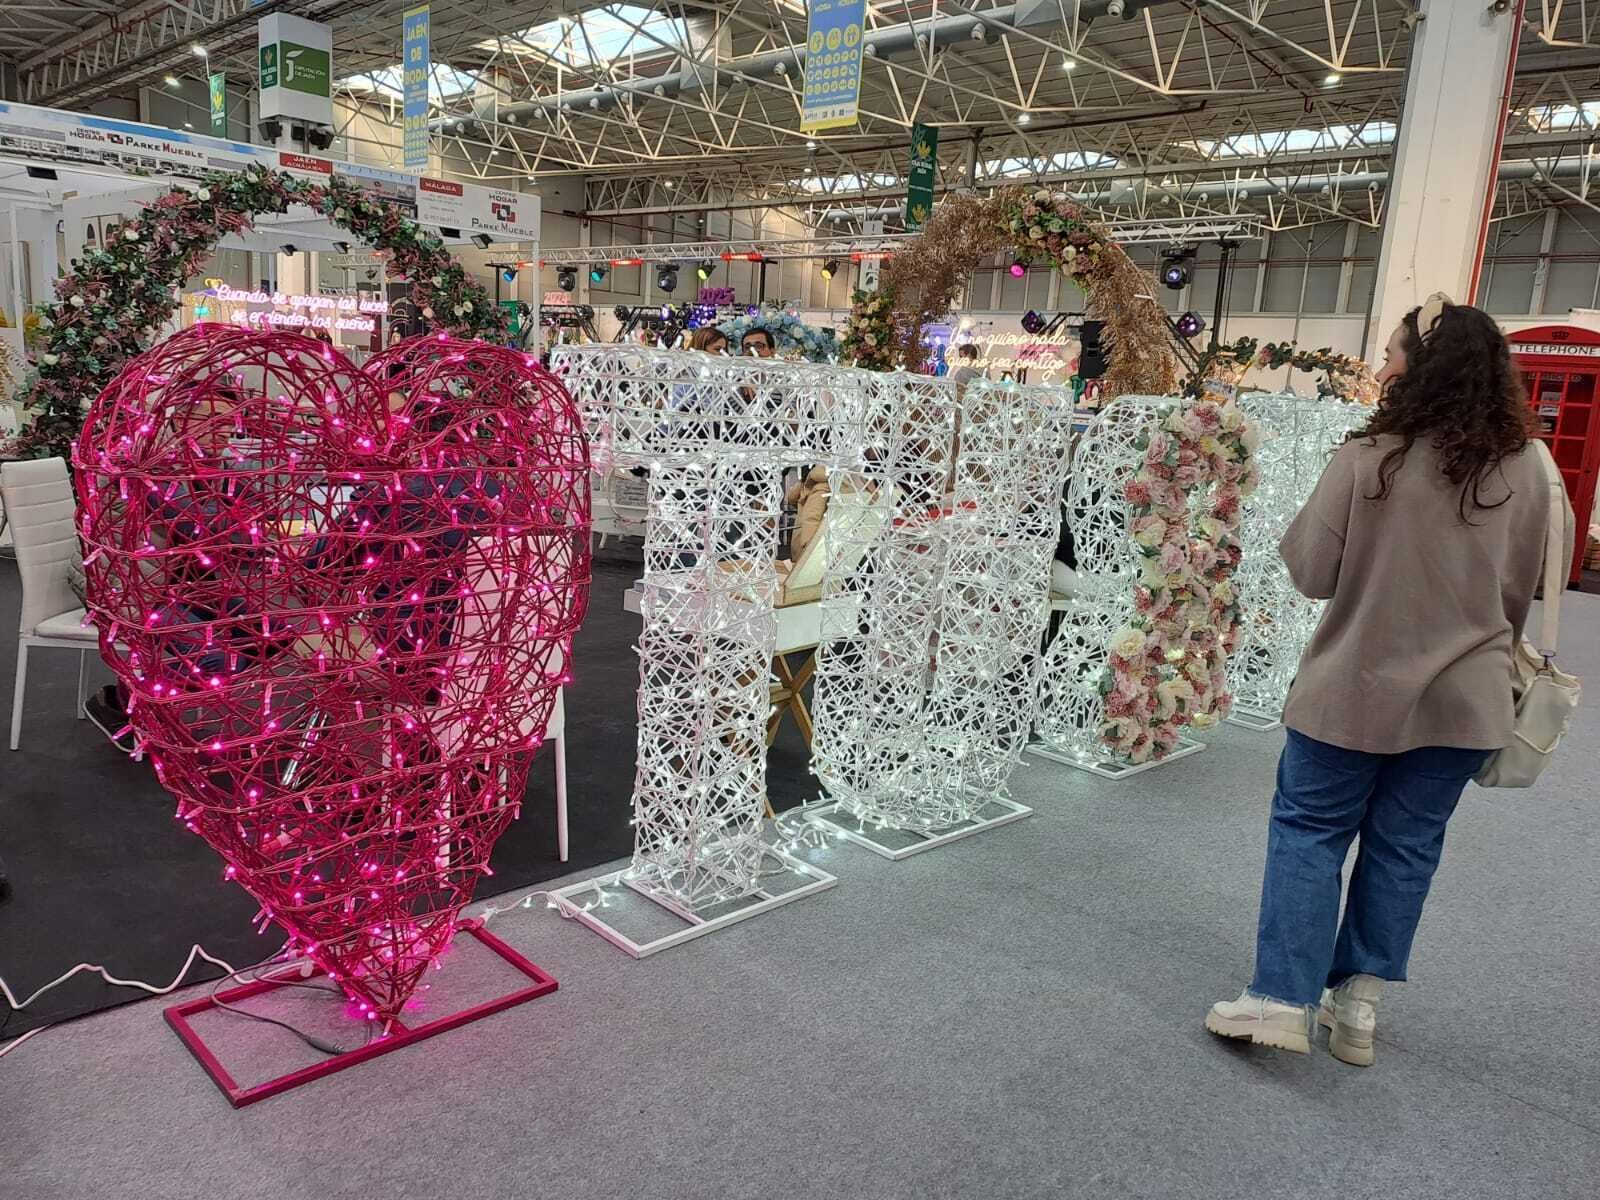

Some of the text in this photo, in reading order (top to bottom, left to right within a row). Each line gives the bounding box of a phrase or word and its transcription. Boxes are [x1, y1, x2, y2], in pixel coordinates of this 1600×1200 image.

[69, 131, 105, 143] HOGAR
[489, 194, 518, 204] HOGAR
[216, 284, 271, 304] Cuando
[271, 292, 288, 305] se
[293, 295, 337, 312] apagan
[359, 298, 389, 313] luces
[230, 310, 248, 322] se
[335, 316, 376, 331] sueños
[1030, 324, 1070, 346] nada
[1519, 343, 1596, 355] TELEPHONE
[1014, 351, 1067, 382] contigo
